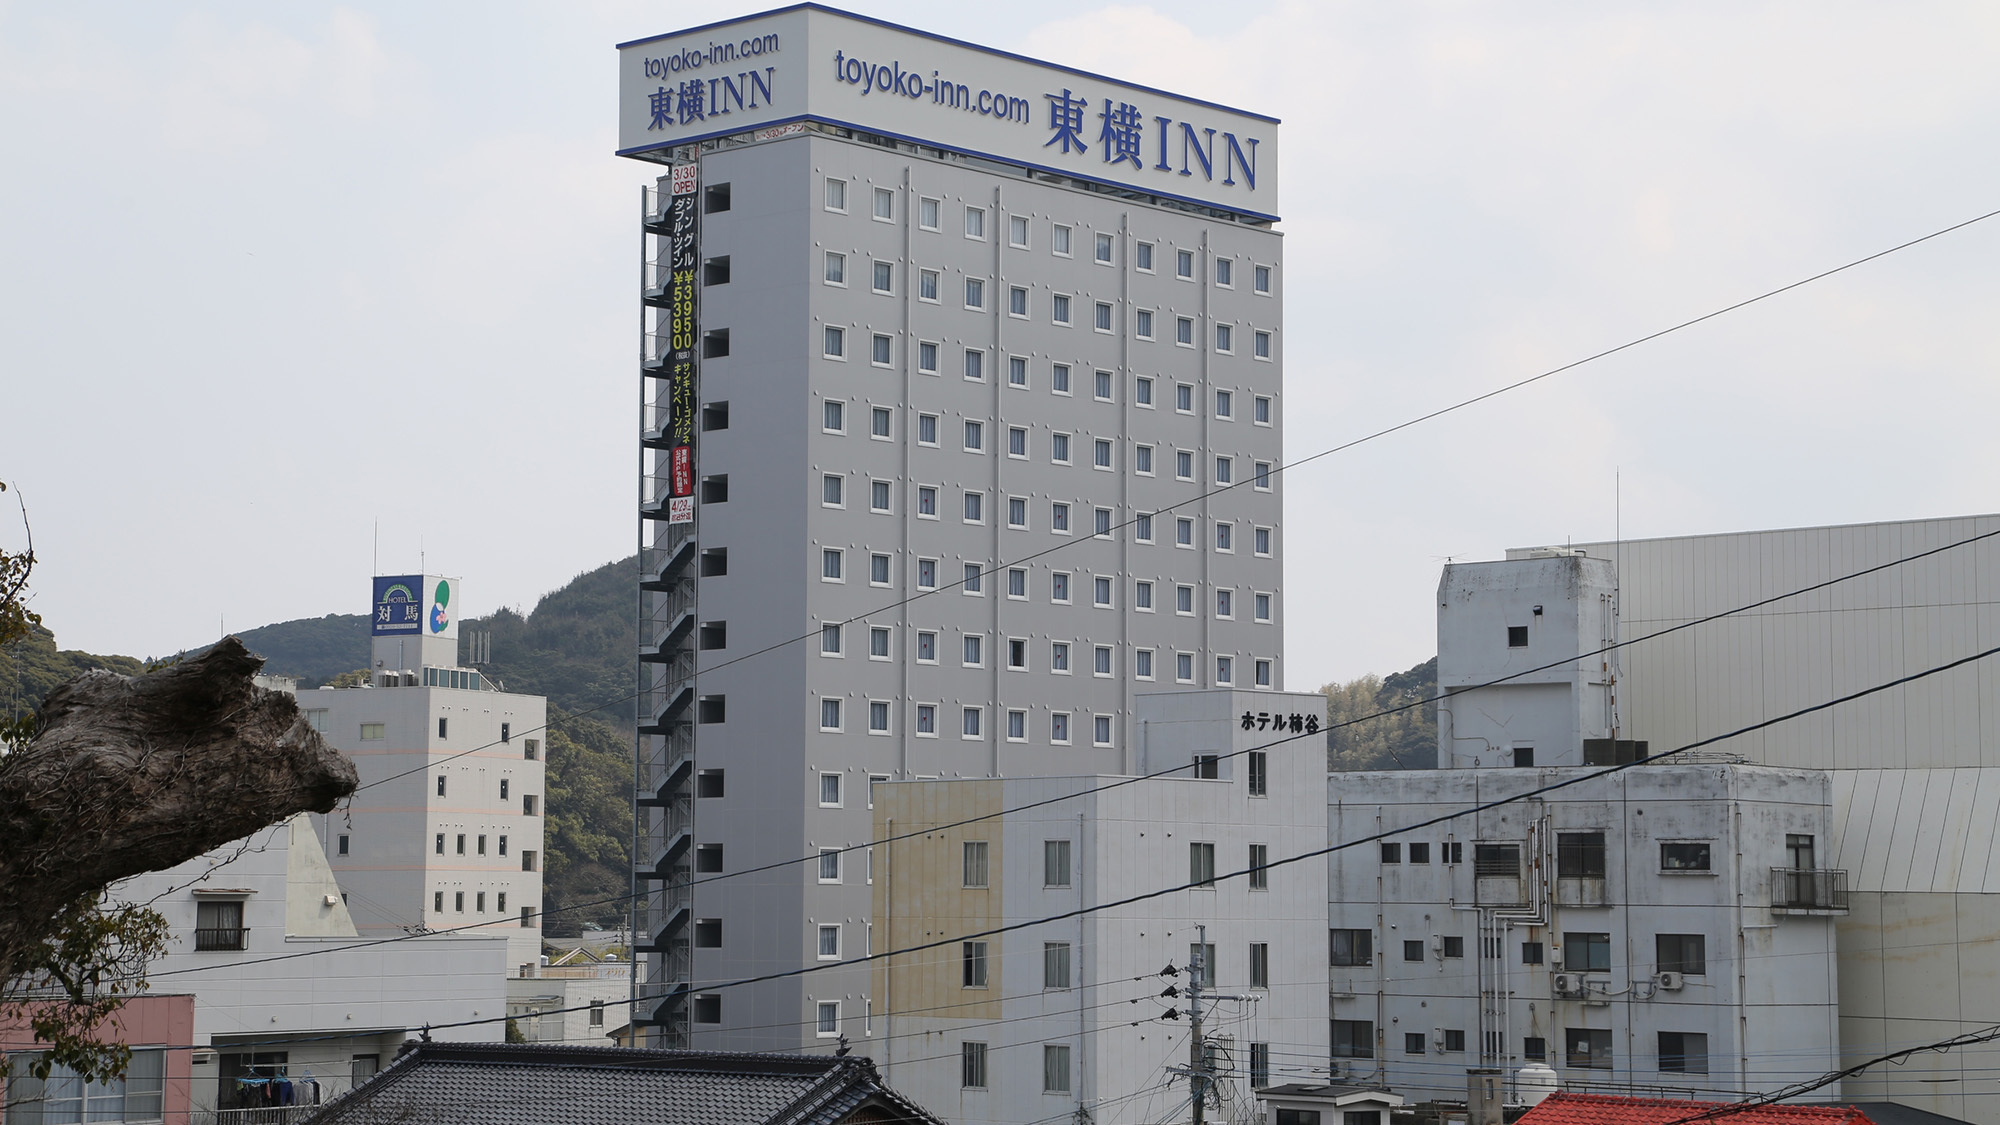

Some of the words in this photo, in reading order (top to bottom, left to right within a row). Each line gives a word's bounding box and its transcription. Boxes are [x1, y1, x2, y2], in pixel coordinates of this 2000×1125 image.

[644, 33, 779, 80] toyoko-inn.com
[648, 67, 776, 130] 東横INN
[835, 50, 1029, 123] toyoko-inn.com
[1044, 89, 1260, 191] 東横INN
[673, 166, 696, 180] 3/30
[673, 180, 696, 194] OPEN
[684, 197, 695, 267] シングル
[388, 596, 407, 604] HOTEL
[376, 604, 419, 623] 対馬
[1241, 711, 1320, 734] ホテル柿谷
